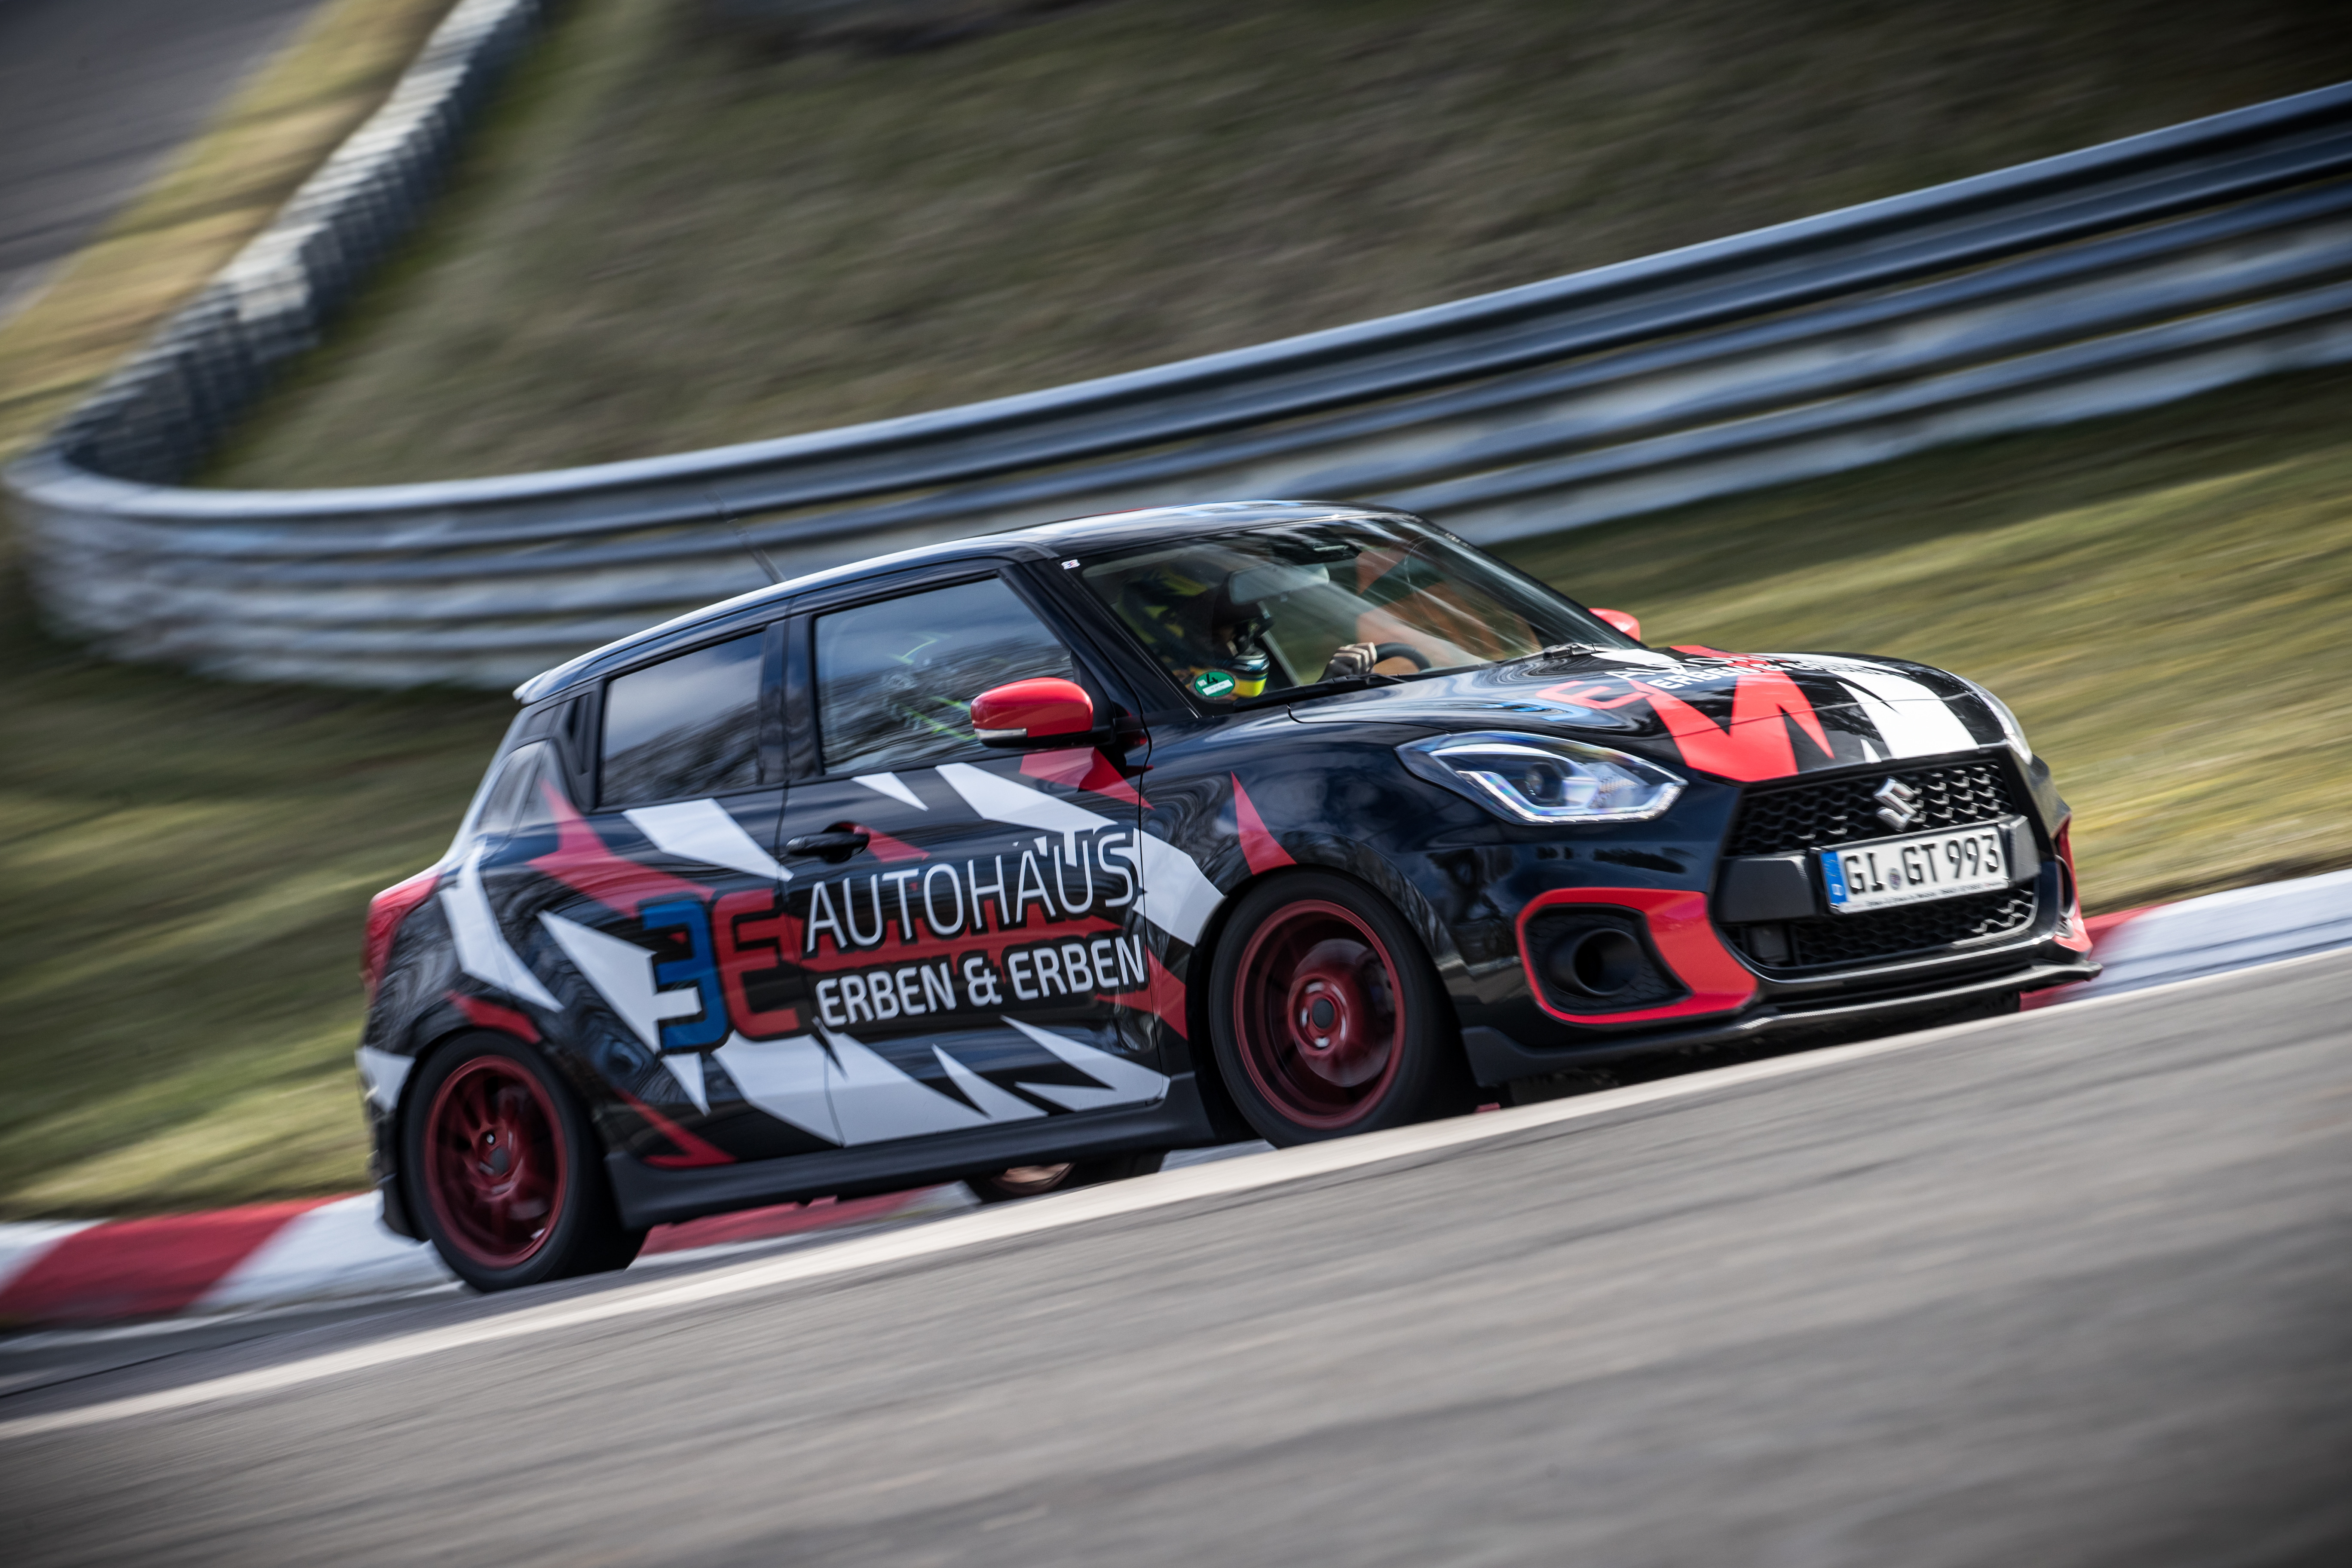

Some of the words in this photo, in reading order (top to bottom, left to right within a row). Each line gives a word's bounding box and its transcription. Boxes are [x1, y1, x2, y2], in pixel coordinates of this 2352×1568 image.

[1206, 673, 1218, 684] 4
[1646, 665, 1763, 689] ERBEN
[807, 833, 1133, 952] AUTOHAUS
[1844, 851, 1887, 895] GI
[1902, 840, 1940, 885] GT
[1946, 830, 2000, 879] 993
[815, 962, 957, 1027] ERBEN
[963, 957, 1003, 1007] &
[1008, 934, 1145, 1001] ERBEN
